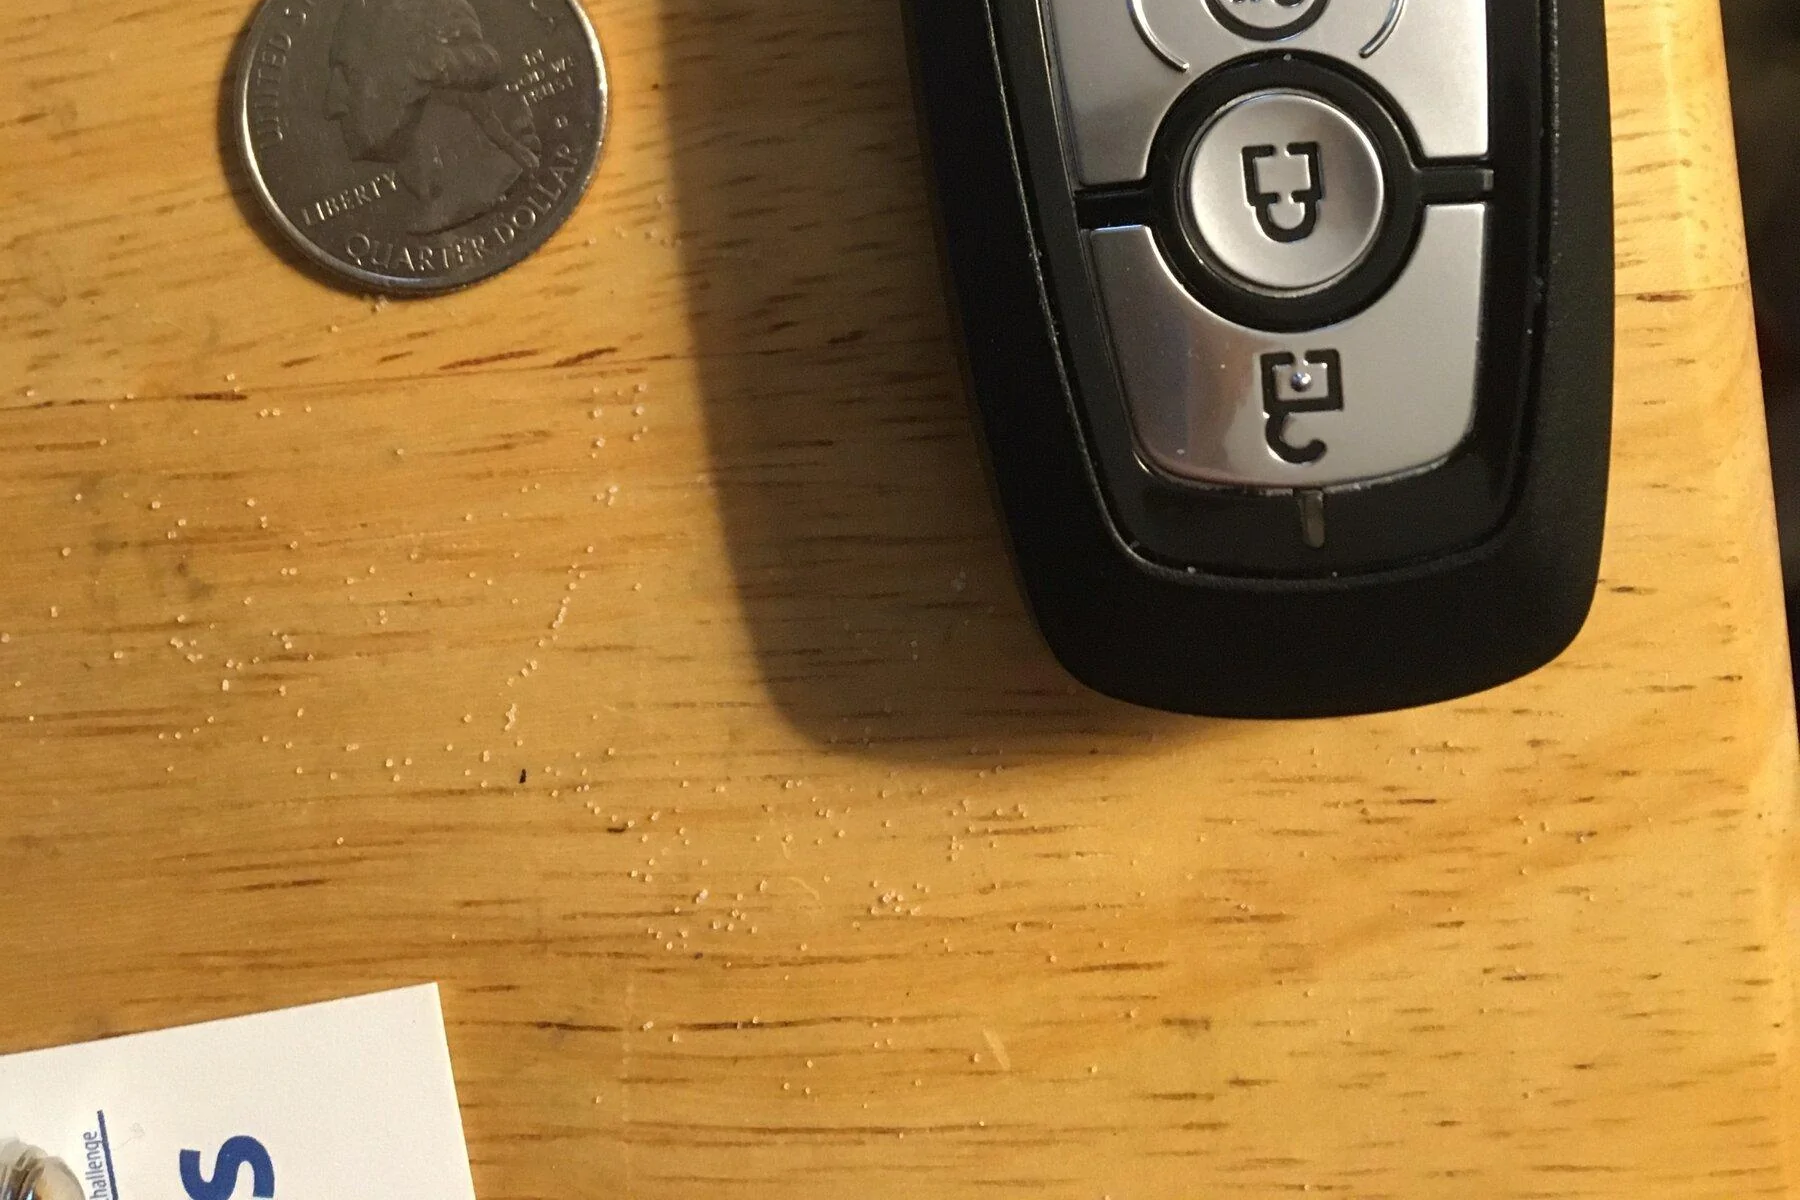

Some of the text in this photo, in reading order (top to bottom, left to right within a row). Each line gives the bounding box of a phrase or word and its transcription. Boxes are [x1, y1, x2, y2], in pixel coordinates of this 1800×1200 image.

[522, 48, 545, 67] IN
[302, 170, 398, 226] LIBERTY
[346, 143, 578, 272] QUARTER DOLLAR
[83, 1131, 107, 1200] hallenge
